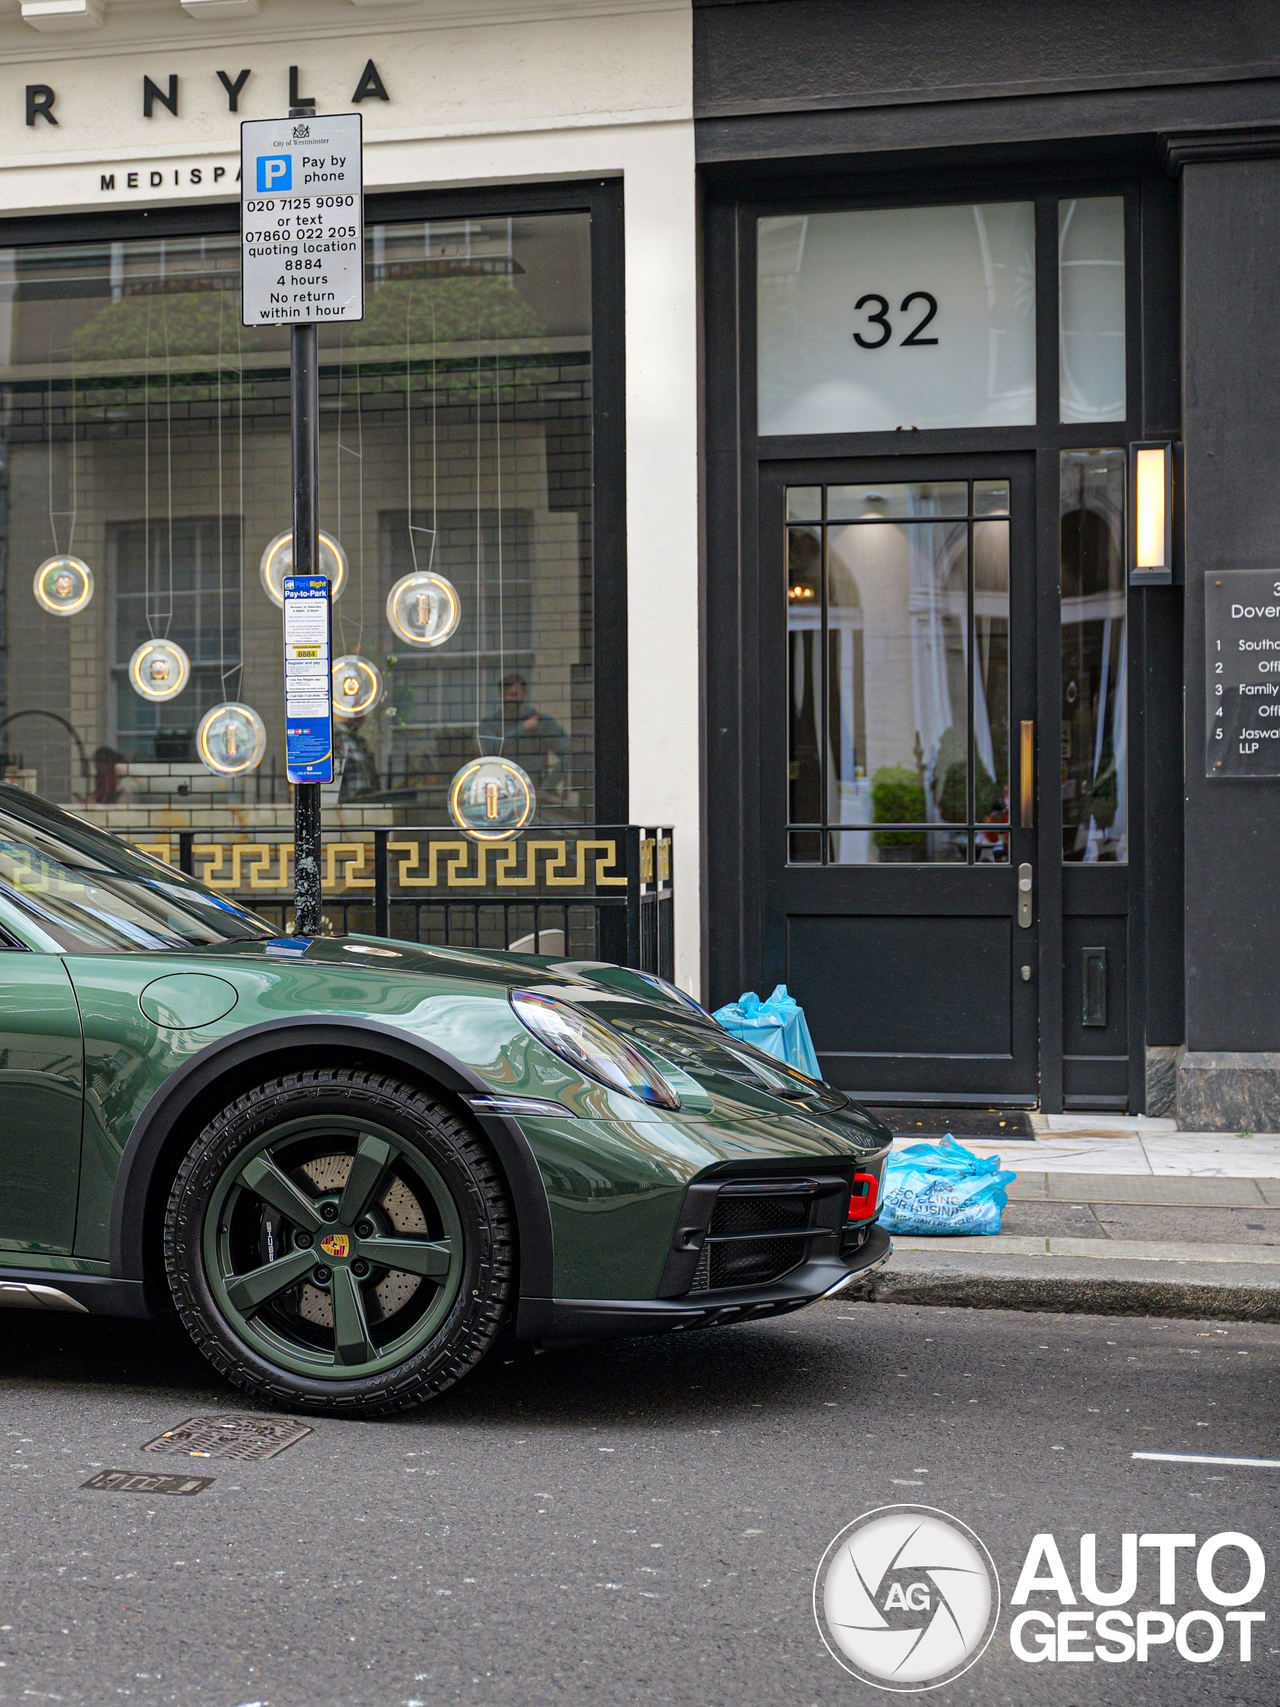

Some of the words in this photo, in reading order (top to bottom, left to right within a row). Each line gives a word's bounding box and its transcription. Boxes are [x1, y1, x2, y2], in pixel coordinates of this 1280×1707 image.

[142, 58, 390, 117] NYLA
[273, 140, 284, 148] City
[286, 139, 292, 147] of
[293, 138, 329, 146] Westminster
[302, 156, 326, 169] Pay
[331, 155, 347, 168] by
[265, 159, 287, 188] P
[304, 171, 345, 185] phone
[247, 200, 275, 212] 020
[280, 198, 311, 211] 7125
[316, 195, 354, 208] 9090
[277, 217, 291, 227] or
[296, 214, 323, 226] text
[245, 229, 291, 243] 07860
[296, 228, 323, 240] 022
[328, 226, 356, 238] 205
[248, 244, 298, 258] quoting
[303, 241, 356, 253] location
[285, 259, 322, 271] 8884
[277, 275, 286, 286] 4
[291, 274, 328, 286] hours
[270, 292, 288, 304] No
[293, 291, 335, 303] return
[260, 306, 300, 319] within
[305, 305, 311, 316] 1
[316, 305, 346, 316] hour
[852, 290, 939, 350] 32
[285, 589, 327, 599] Pay-to-Park
[1215, 639, 1222, 651] 1
[298, 650, 316, 658] 8884
[1215, 662, 1223, 674] 2
[1215, 684, 1223, 696] 3
[1239, 683, 1279, 697] Family
[1215, 706, 1224, 718] 4
[1215, 728, 1223, 740] 5
[1239, 742, 1260, 754] LLP
[913, 1216, 931, 1226] CAN
